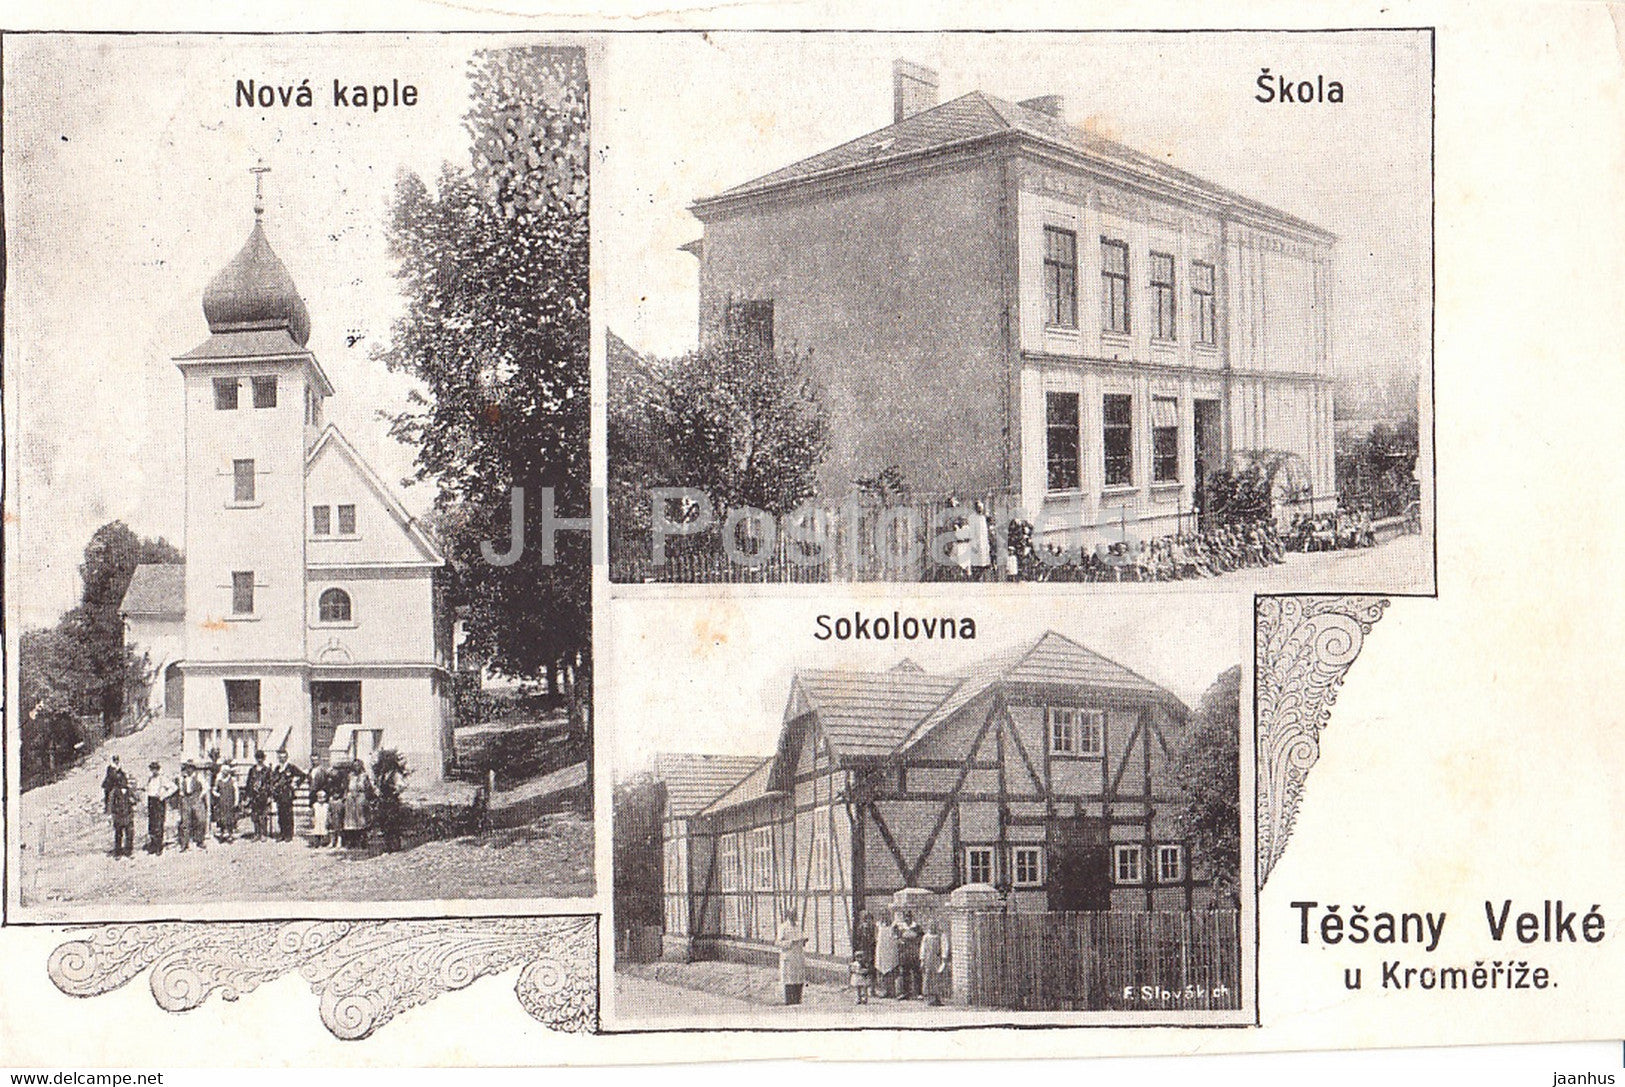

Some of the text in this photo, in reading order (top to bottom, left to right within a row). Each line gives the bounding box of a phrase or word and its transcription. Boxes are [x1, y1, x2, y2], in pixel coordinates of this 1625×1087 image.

[235, 78, 419, 113] Nová kaple
[1255, 68, 1345, 104] Škola
[813, 611, 977, 641] Sokolovna
[1290, 899, 1607, 952] Těšany Velké
[1344, 960, 1559, 990] u Kroměříže.
